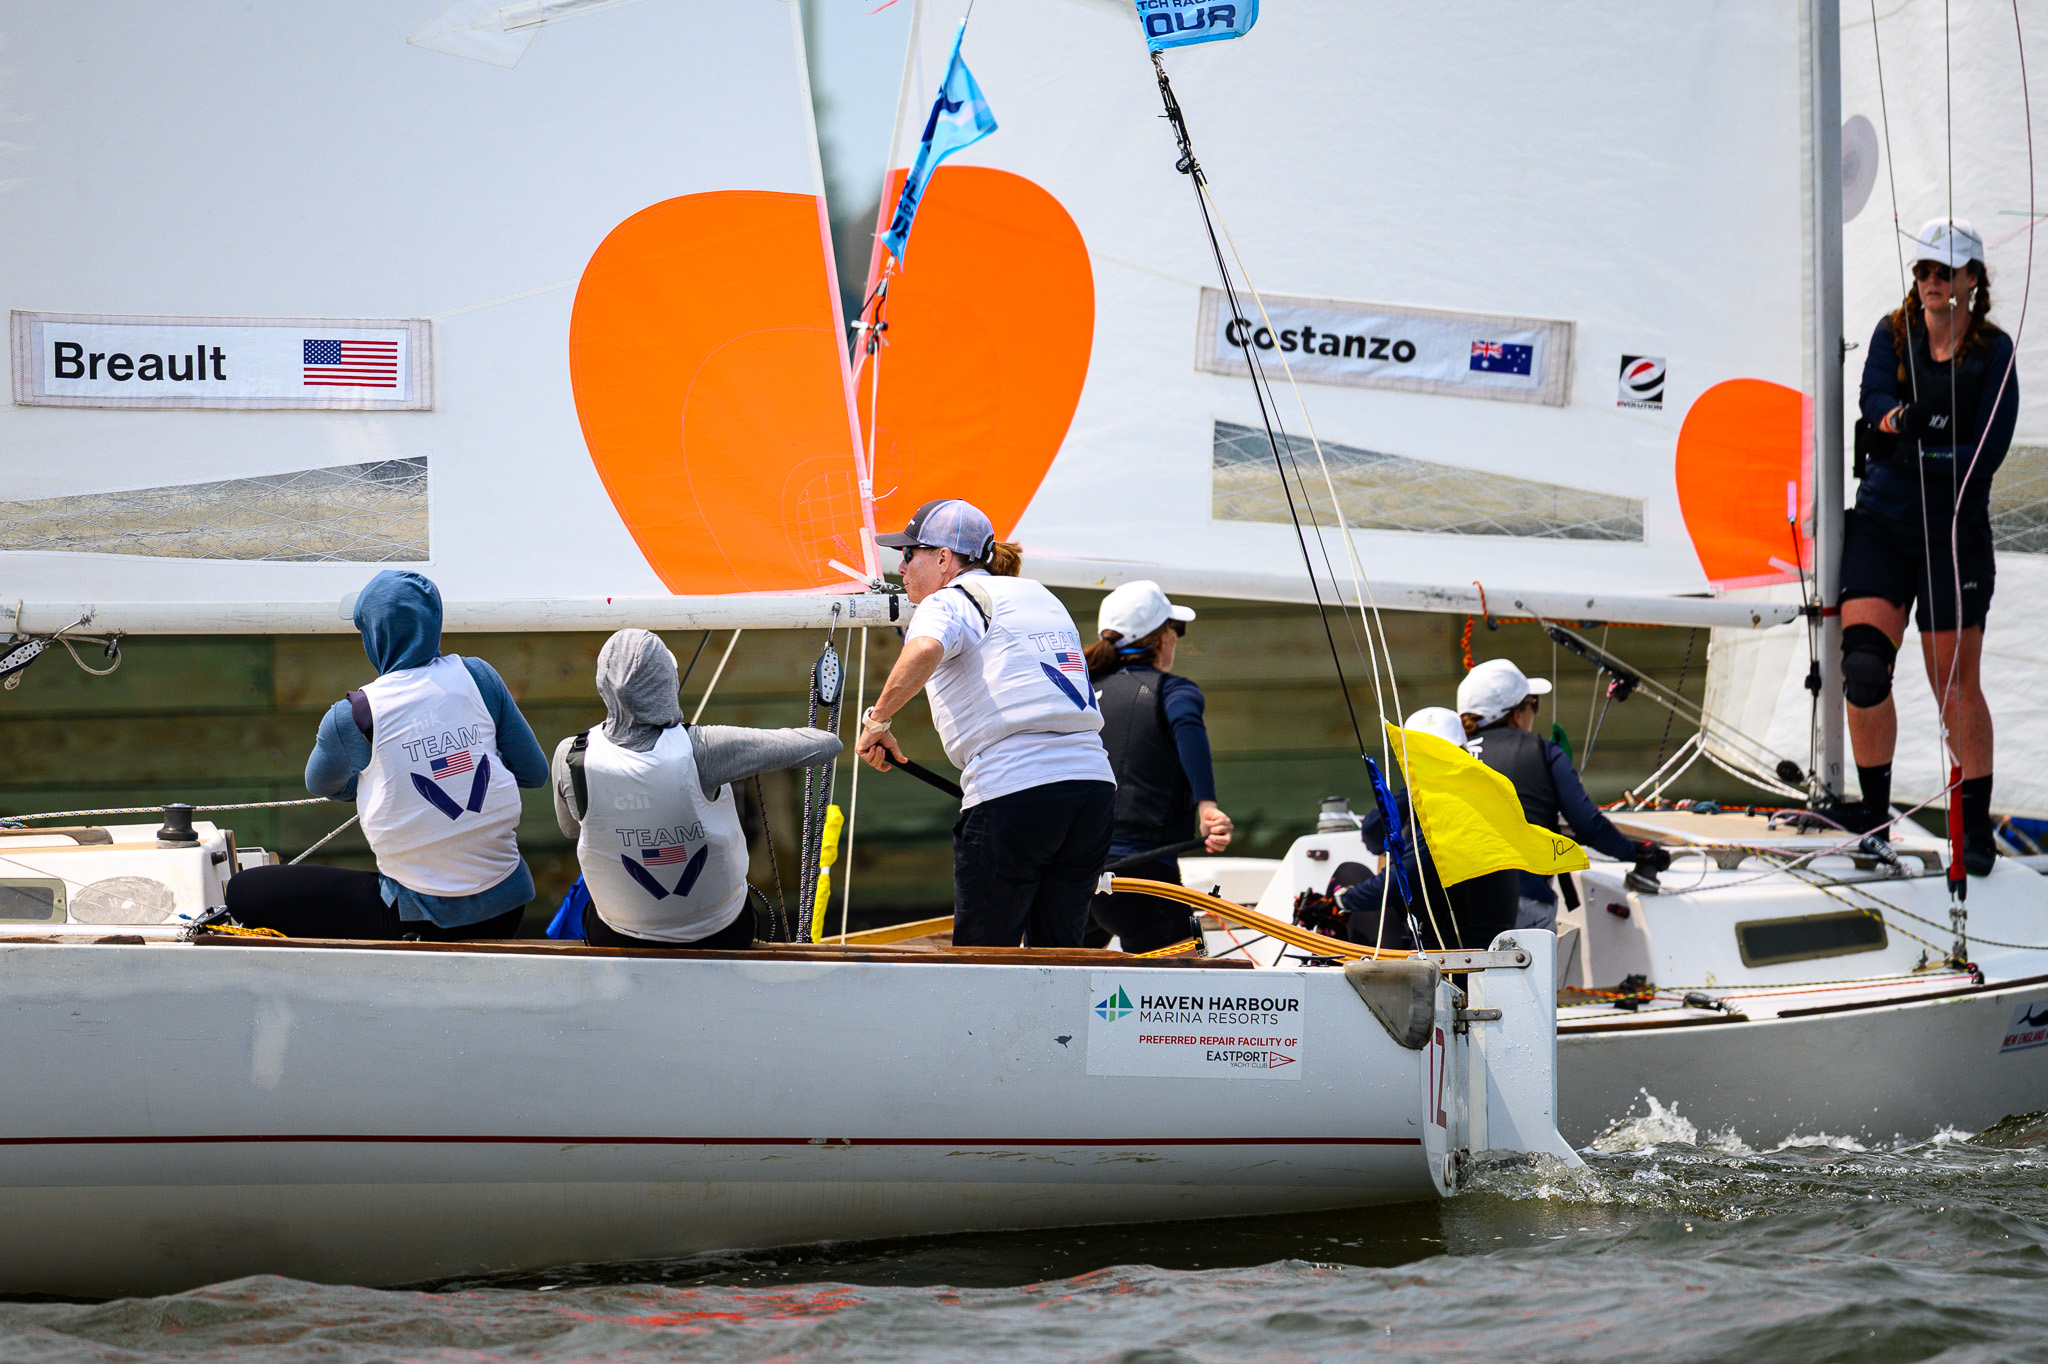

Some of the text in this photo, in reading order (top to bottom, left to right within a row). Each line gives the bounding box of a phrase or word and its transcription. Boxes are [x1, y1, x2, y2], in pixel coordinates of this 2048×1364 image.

[1225, 318, 1416, 363] Costanzo
[54, 341, 227, 381] Breault
[402, 724, 482, 762] TEAM
[616, 820, 705, 847] TEAM
[1140, 995, 1299, 1012] HAVEN HARBOUR
[1139, 1011, 1279, 1025] MARINA RESORTS
[1139, 1035, 1298, 1047] PREFERRED REPAIR FACILITY OF
[1206, 1050, 1268, 1063] EASTPORT
